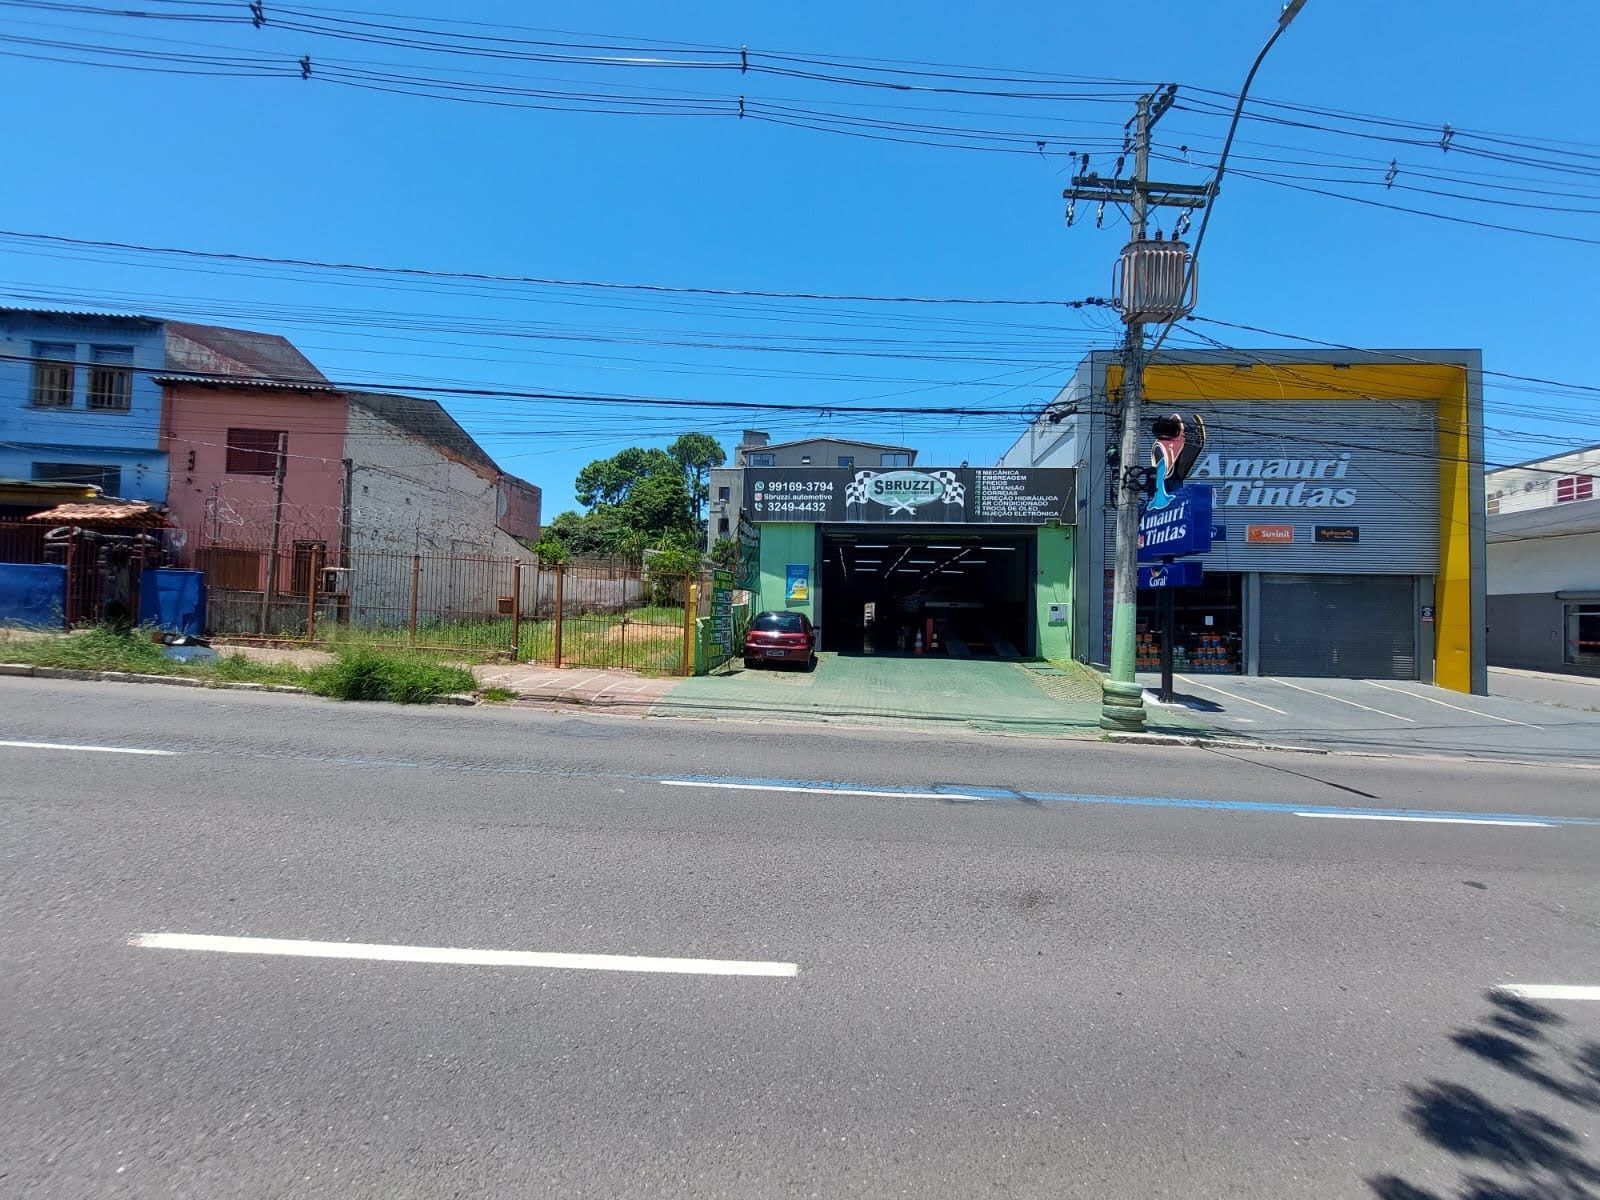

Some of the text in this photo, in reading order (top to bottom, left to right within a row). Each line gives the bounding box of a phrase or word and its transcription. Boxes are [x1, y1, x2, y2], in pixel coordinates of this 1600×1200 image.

[1191, 453, 1349, 479] Amauri
[768, 482, 834, 492] 99169-3794
[874, 480, 935, 495] SBRUZZI
[1223, 480, 1357, 507] Tintas
[767, 502, 826, 512] 3249-4432
[1139, 502, 1186, 531] Amauri
[1146, 524, 1187, 546] Tintas
[1262, 530, 1290, 538] Suvinil
[1149, 576, 1166, 587] Coral
